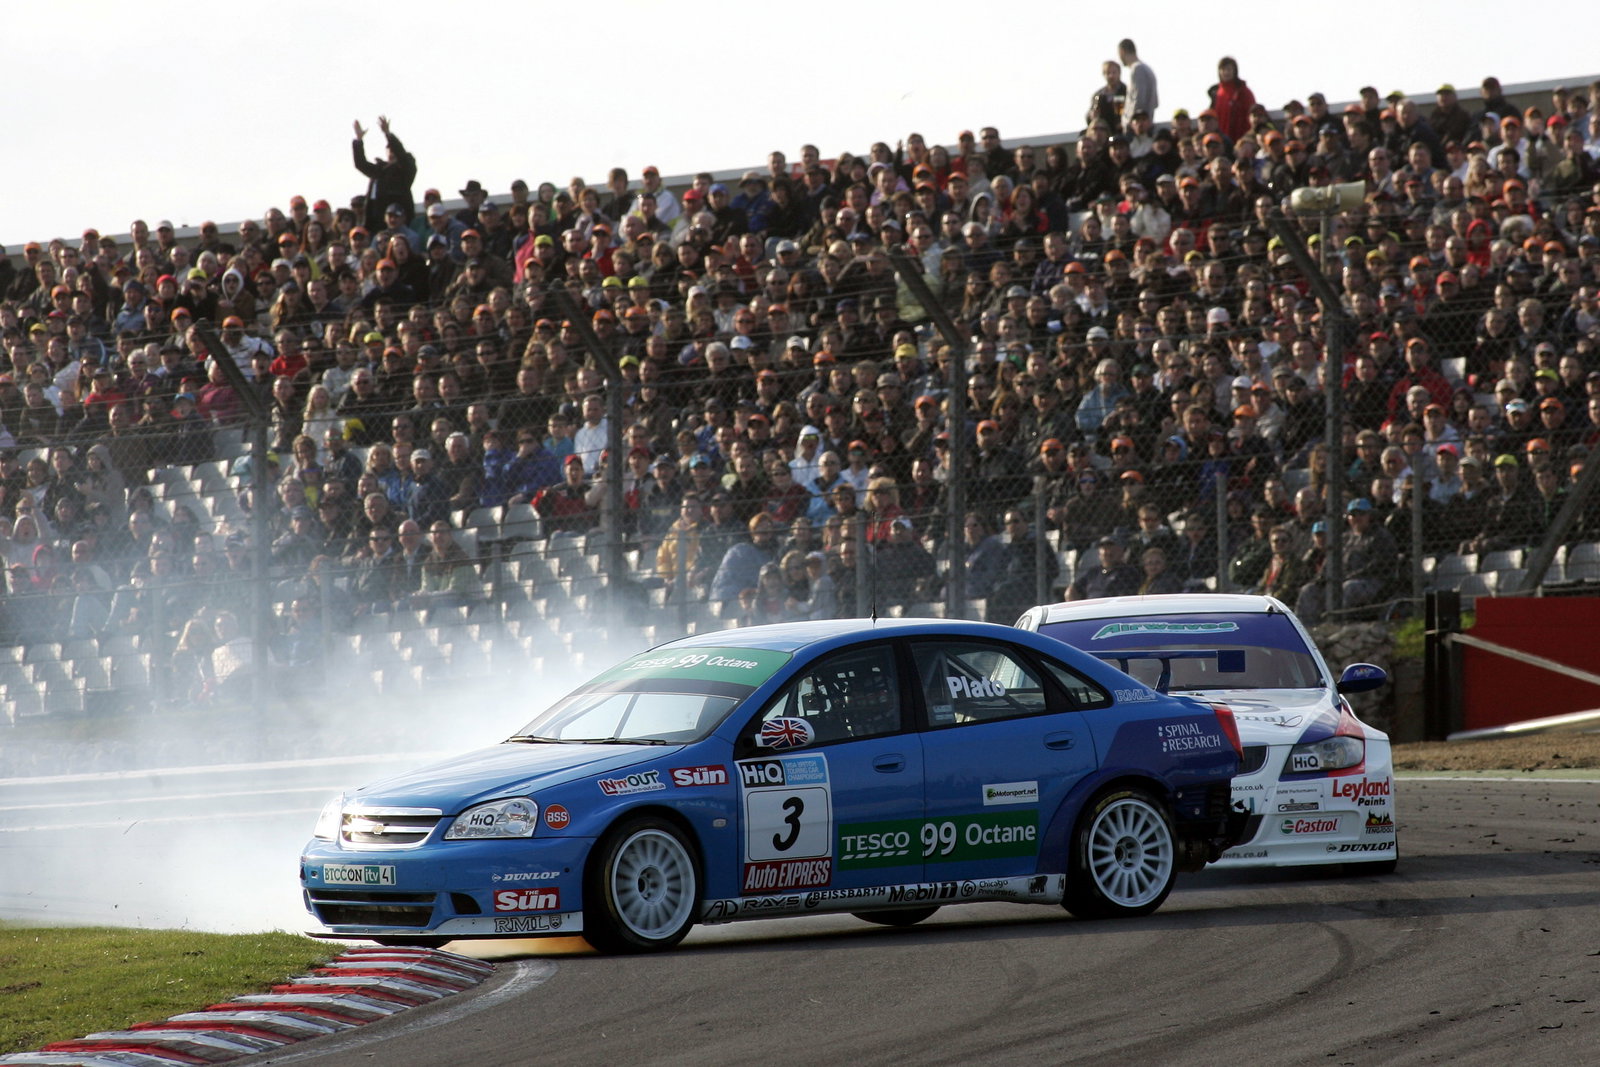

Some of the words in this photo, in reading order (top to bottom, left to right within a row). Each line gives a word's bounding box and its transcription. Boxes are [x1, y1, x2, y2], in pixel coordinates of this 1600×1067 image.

[672, 654, 708, 669] 99
[706, 655, 757, 669] Octane
[947, 676, 1005, 699] Plato
[1165, 723, 1203, 737] SPINAL
[1168, 734, 1221, 751] RESEARCH
[1294, 756, 1319, 768] HiQ
[673, 769, 725, 786] Sun
[742, 763, 783, 784] HiQ
[1332, 776, 1390, 802] Leyland
[1357, 797, 1385, 807] Paints
[470, 814, 495, 826] HiQ
[547, 812, 568, 823] BSS
[773, 797, 804, 851] 3
[1294, 818, 1338, 833] Castrol
[841, 831, 910, 851] TESCO
[920, 821, 957, 857] 99
[965, 823, 1035, 846] Octane
[1338, 841, 1394, 852] DUNLOP
[365, 868, 378, 881] itv
[502, 871, 560, 881] DUNLOP
[745, 864, 778, 889] Auto
[778, 860, 830, 887] EXPRESS
[979, 879, 1008, 888] Chicago
[812, 887, 886, 901] BEISSBARTH
[888, 882, 937, 903] Mobil
[495, 893, 557, 911] Sun
[744, 896, 799, 909] RAYS
[495, 916, 549, 933] RML
